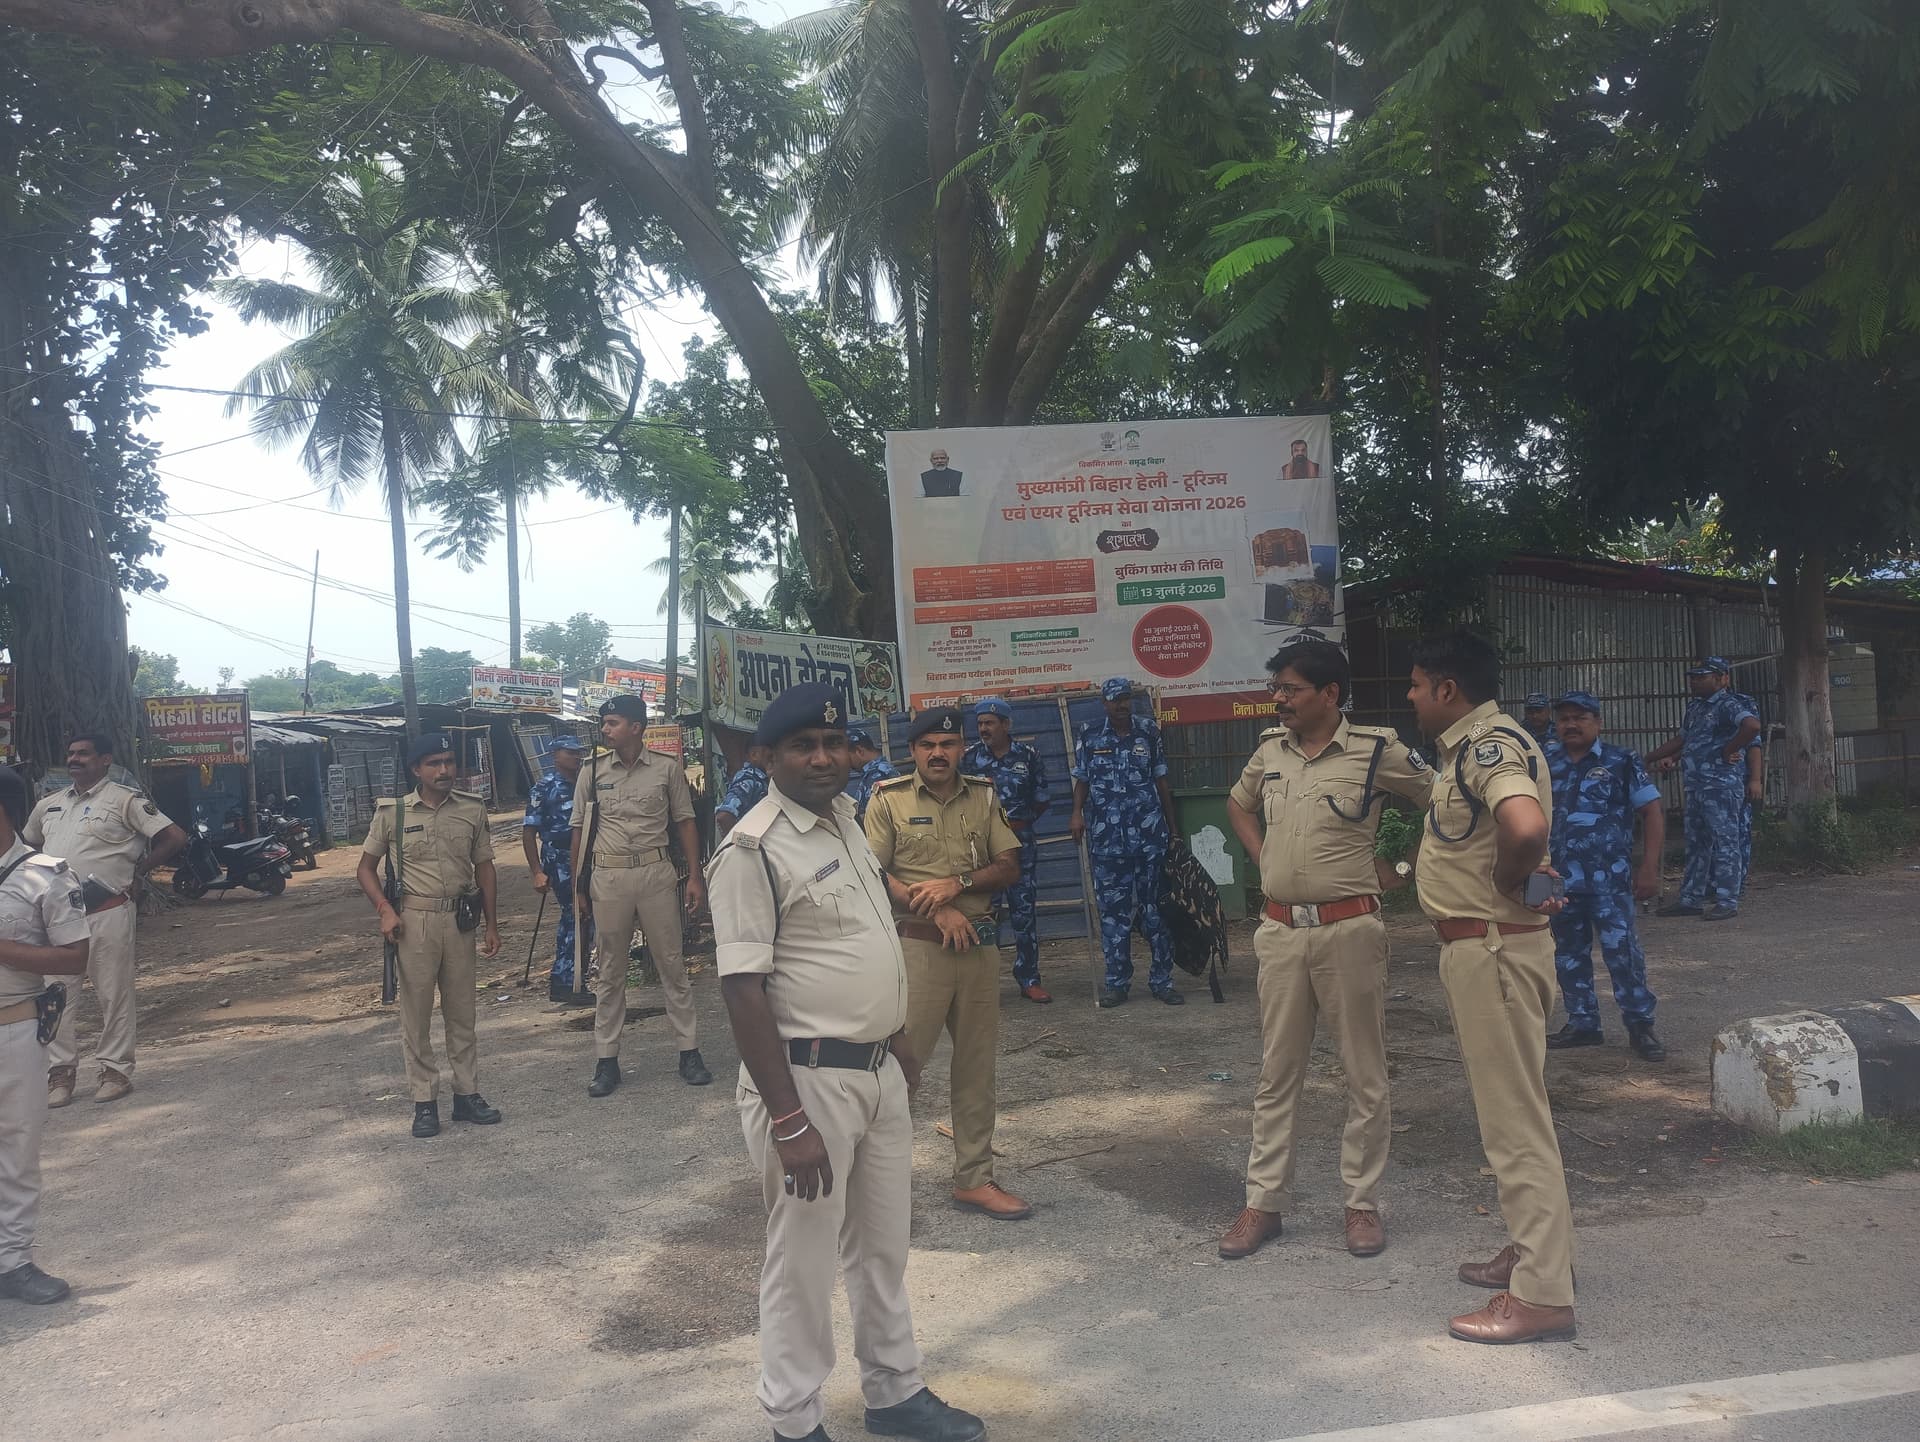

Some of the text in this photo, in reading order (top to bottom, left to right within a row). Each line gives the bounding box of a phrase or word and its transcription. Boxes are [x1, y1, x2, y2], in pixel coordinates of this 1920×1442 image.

[1078, 459, 1105, 468] विकसित
[1107, 459, 1123, 467] भारत
[1128, 458, 1146, 467] समृद्ध
[1147, 456, 1165, 465] बिहार
[1016, 476, 1085, 500] मुख्यमंत्री
[1088, 475, 1132, 492] बिहार
[1136, 471, 1168, 490] हेली
[1183, 470, 1228, 492] टूरिज्म
[1002, 496, 1247, 523] एवं एयर टूरिज्म सेवा योजना 2026
[1121, 519, 1132, 528] का
[1106, 531, 1148, 550] शुभारंभ
[1115, 558, 1224, 580] बुकिंग प्रारंभ की तिथि
[1140, 583, 1217, 599] 13 जुलाई 2026
[953, 628, 968, 637] नोट
[1153, 625, 1172, 636] जुलाई
[1165, 633, 1190, 642] शनिवार
[1162, 643, 1172, 651] को
[1157, 652, 1171, 660] सेवा
[737, 650, 793, 701] अपना
[926, 663, 1073, 682] बिहार राज्य पर्यटन विकास निगम लिमिटेड
[540, 674, 560, 688] होटल
[145, 698, 243, 728] सिंहजी होटल
[1233, 703, 1254, 716] जिला
